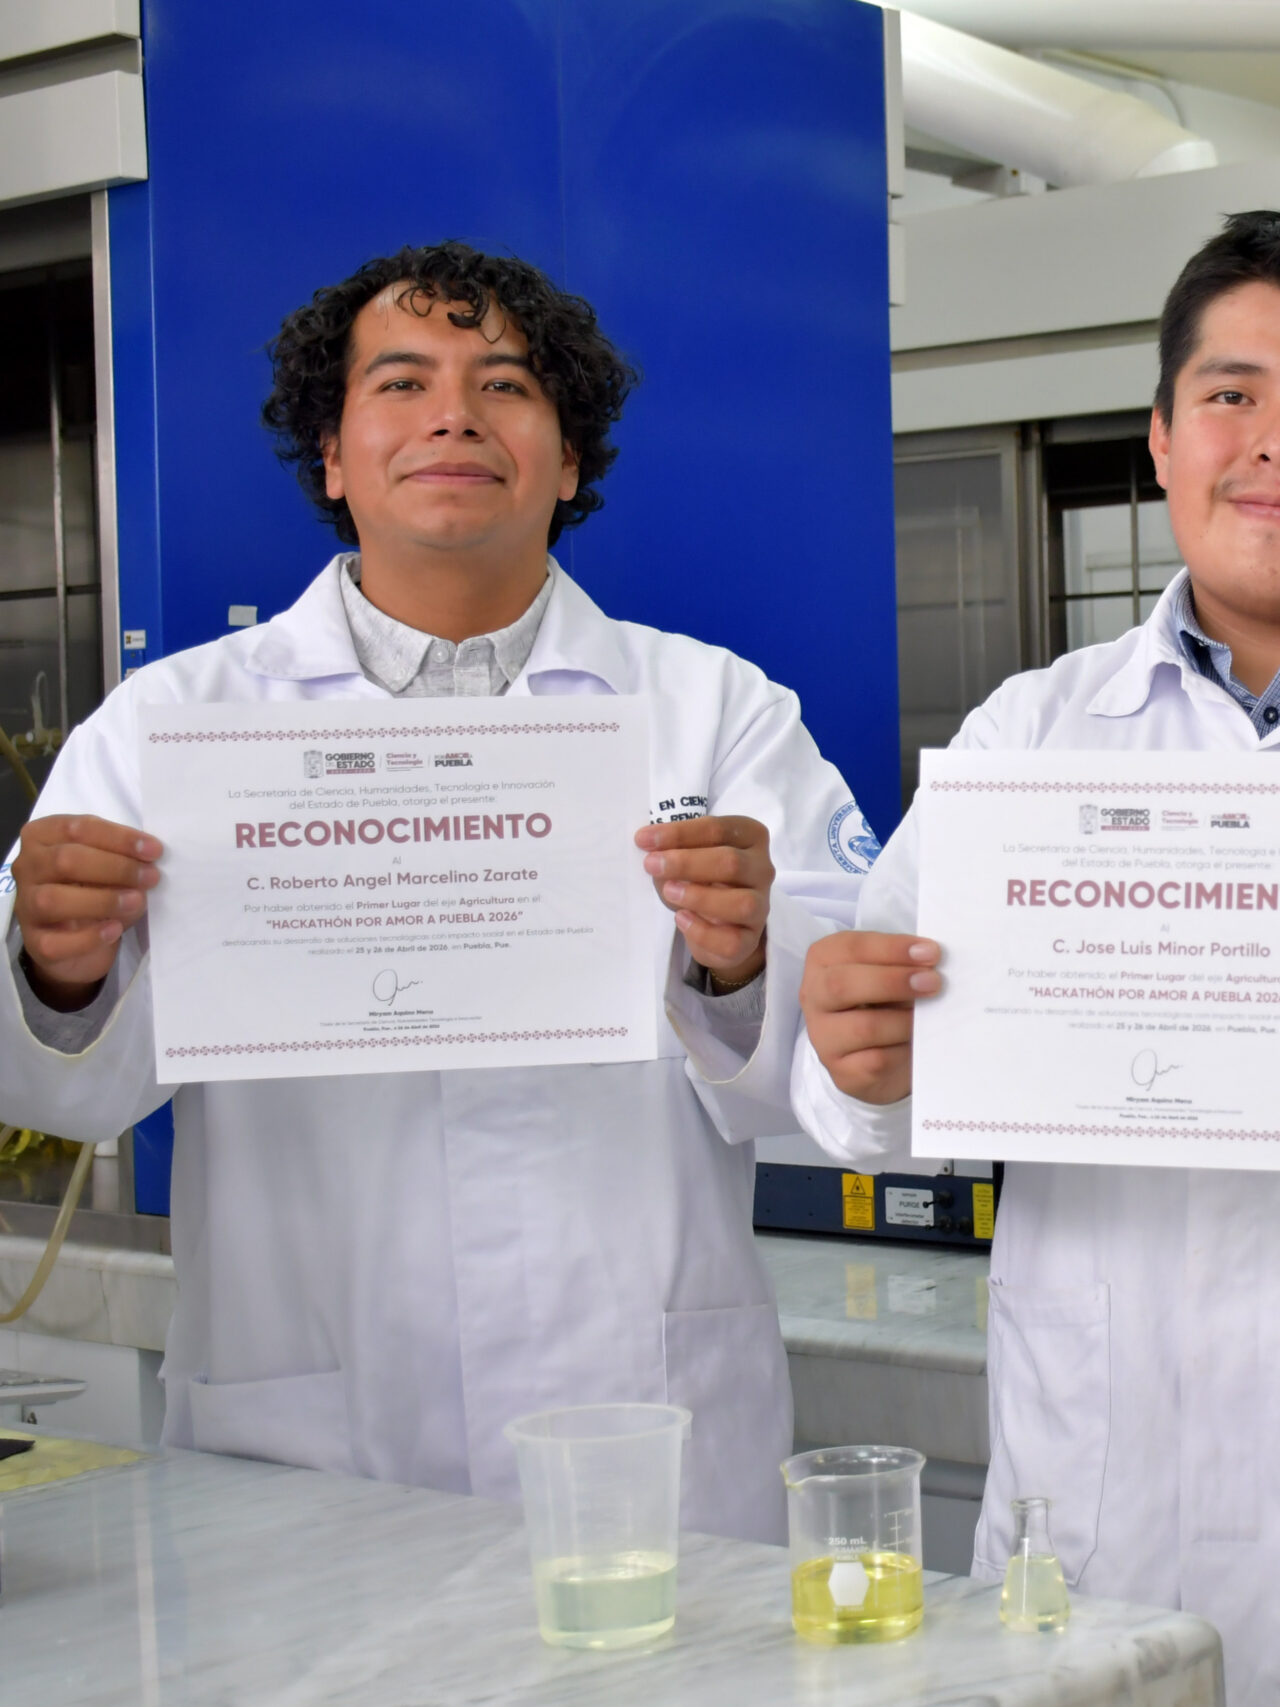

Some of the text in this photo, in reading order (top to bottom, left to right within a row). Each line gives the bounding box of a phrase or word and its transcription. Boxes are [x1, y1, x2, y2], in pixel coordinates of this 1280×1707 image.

[336, 760, 375, 769] ESTADO
[434, 759, 473, 767] PUEBLA
[659, 798, 675, 811] EN
[235, 812, 552, 848] RECONOCIMIENTO
[246, 868, 537, 890] C. Roberto Angel Marcelino Zarate
[244, 904, 260, 913] Por
[263, 903, 293, 912] haber
[296, 901, 342, 911] obtenido
[345, 900, 354, 909] el
[356, 900, 389, 909] Primer
[391, 899, 421, 910] Lugar
[423, 898, 438, 907] del
[441, 898, 456, 908] eje
[458, 895, 514, 907] Agricultura
[355, 916, 382, 927] POR
[385, 915, 423, 926] AMOR
[426, 914, 435, 924] A
[439, 912, 485, 923] PUEBLA
[1052, 938, 1271, 958] C. Jose Luis Minor Portillo
[1118, 988, 1145, 1000] POR
[1148, 989, 1187, 1001] AMOR
[1191, 990, 1200, 1001] A
[1204, 991, 1252, 1002] PUEBLA
[828, 1536, 866, 1546] 250 mL
